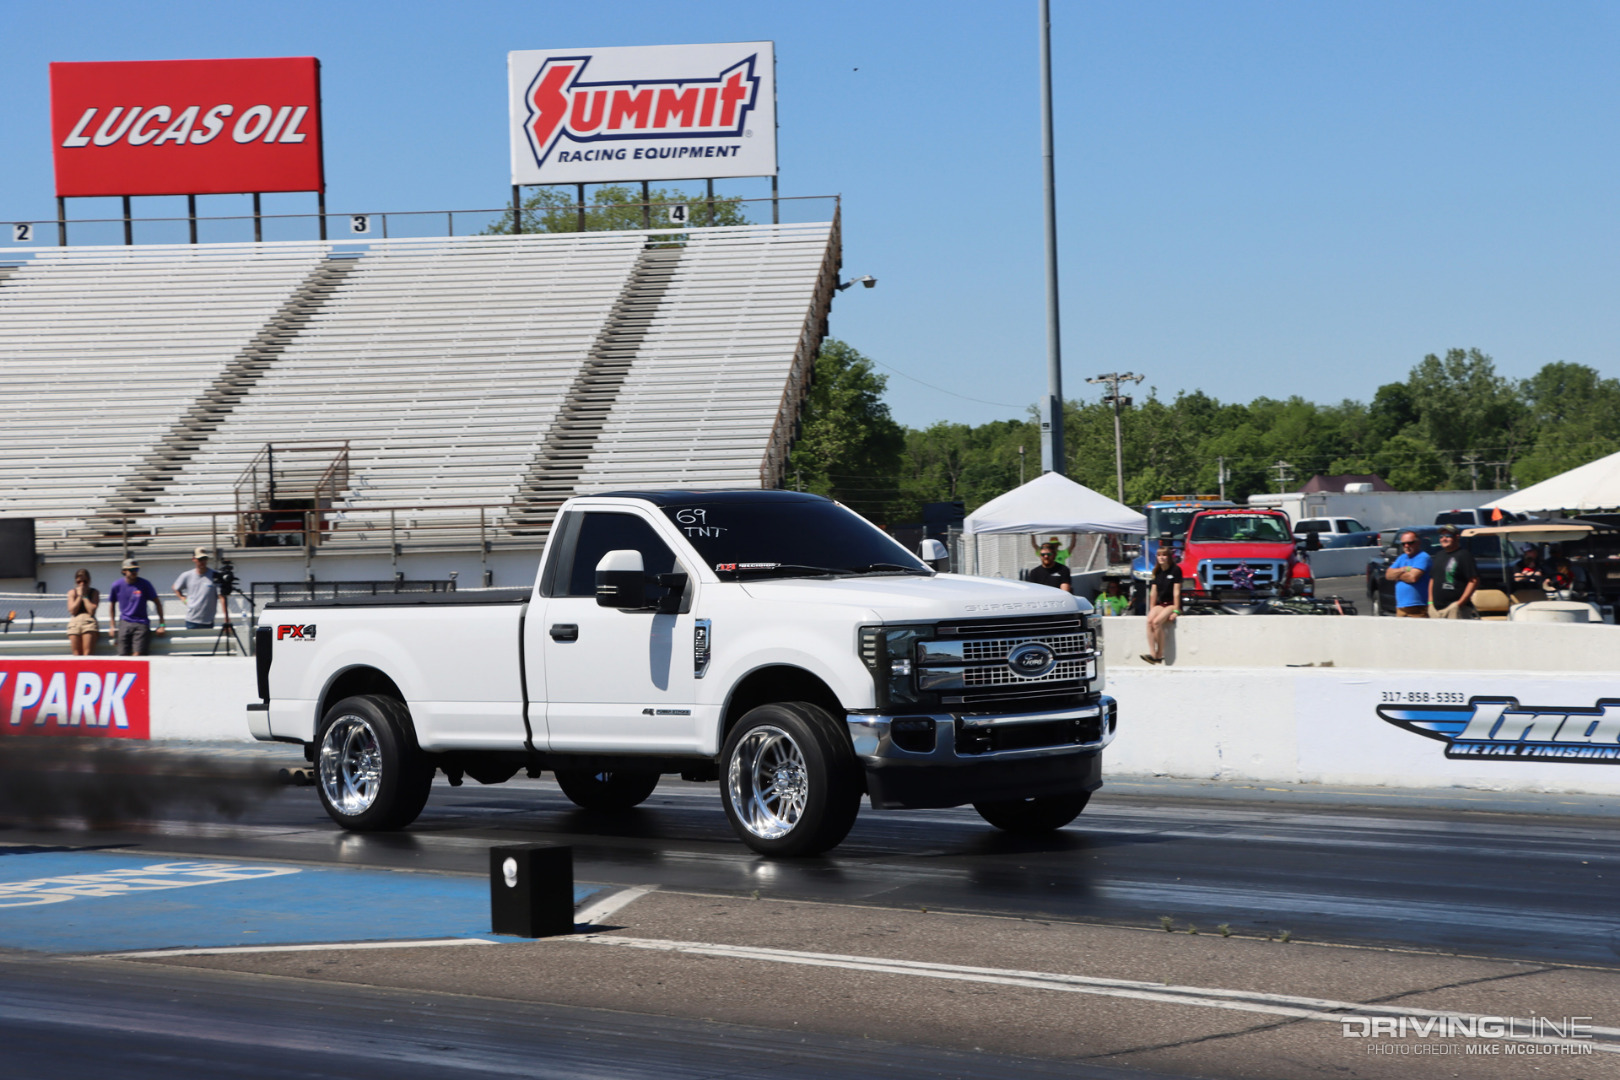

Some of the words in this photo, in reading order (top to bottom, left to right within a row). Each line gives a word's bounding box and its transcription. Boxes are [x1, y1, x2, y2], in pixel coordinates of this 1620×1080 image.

[61, 104, 235, 148] LUCAS
[231, 104, 310, 145] OIL
[558, 149, 627, 163] RACING
[633, 145, 742, 160] EQUIPMENT
[673, 205, 685, 221] 4
[354, 215, 366, 232] 3
[16, 224, 29, 241] 2
[676, 508, 706, 525] 69
[684, 526, 728, 538] TNT
[277, 624, 317, 641] FX4
[1022, 653, 1044, 666] Ford
[10, 671, 138, 729] PARK
[1381, 691, 1465, 703] 317-858-5353
[1449, 744, 1518, 756] METAL
